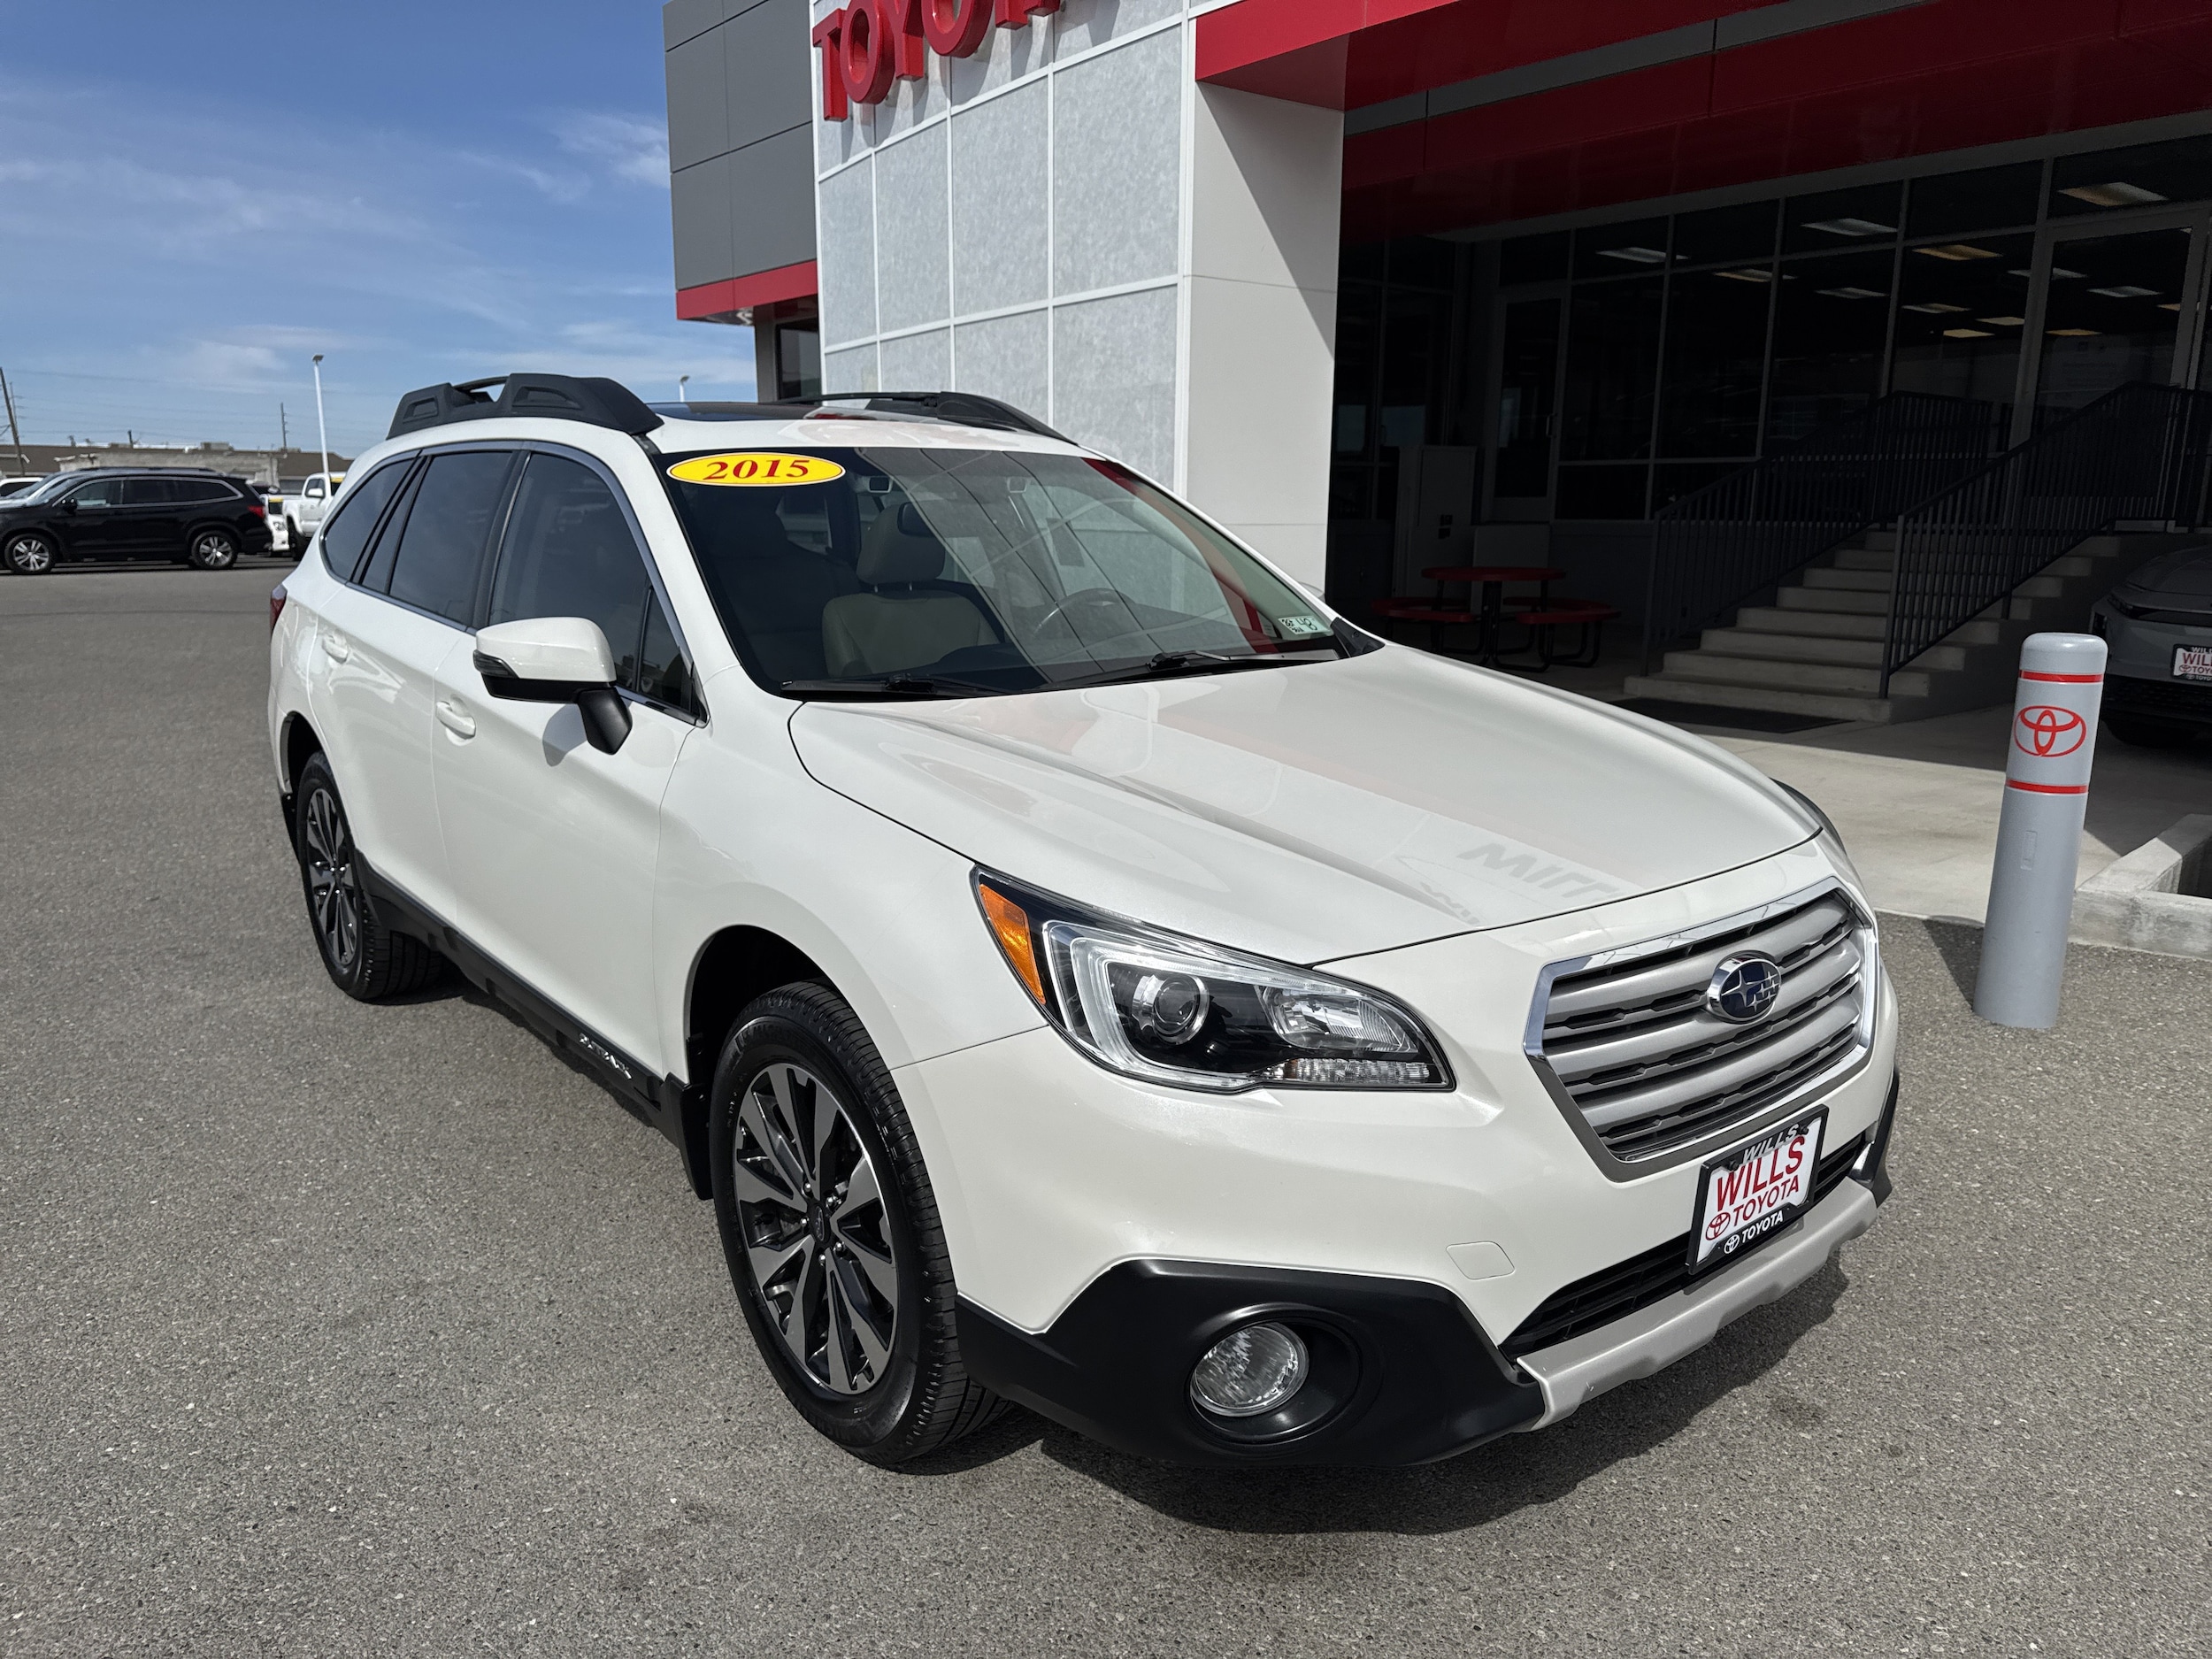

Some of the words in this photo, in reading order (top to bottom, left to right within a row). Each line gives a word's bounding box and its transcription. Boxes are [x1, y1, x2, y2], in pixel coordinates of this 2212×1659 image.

[703, 458, 810, 480] 2015
[2183, 652, 2212, 666] WIL
[1742, 1124, 1799, 1165] WILLS
[1717, 1136, 1805, 1211] WILLS
[1733, 1175, 1799, 1226] TOYOTA
[1742, 1210, 1784, 1243] TOYOTA
